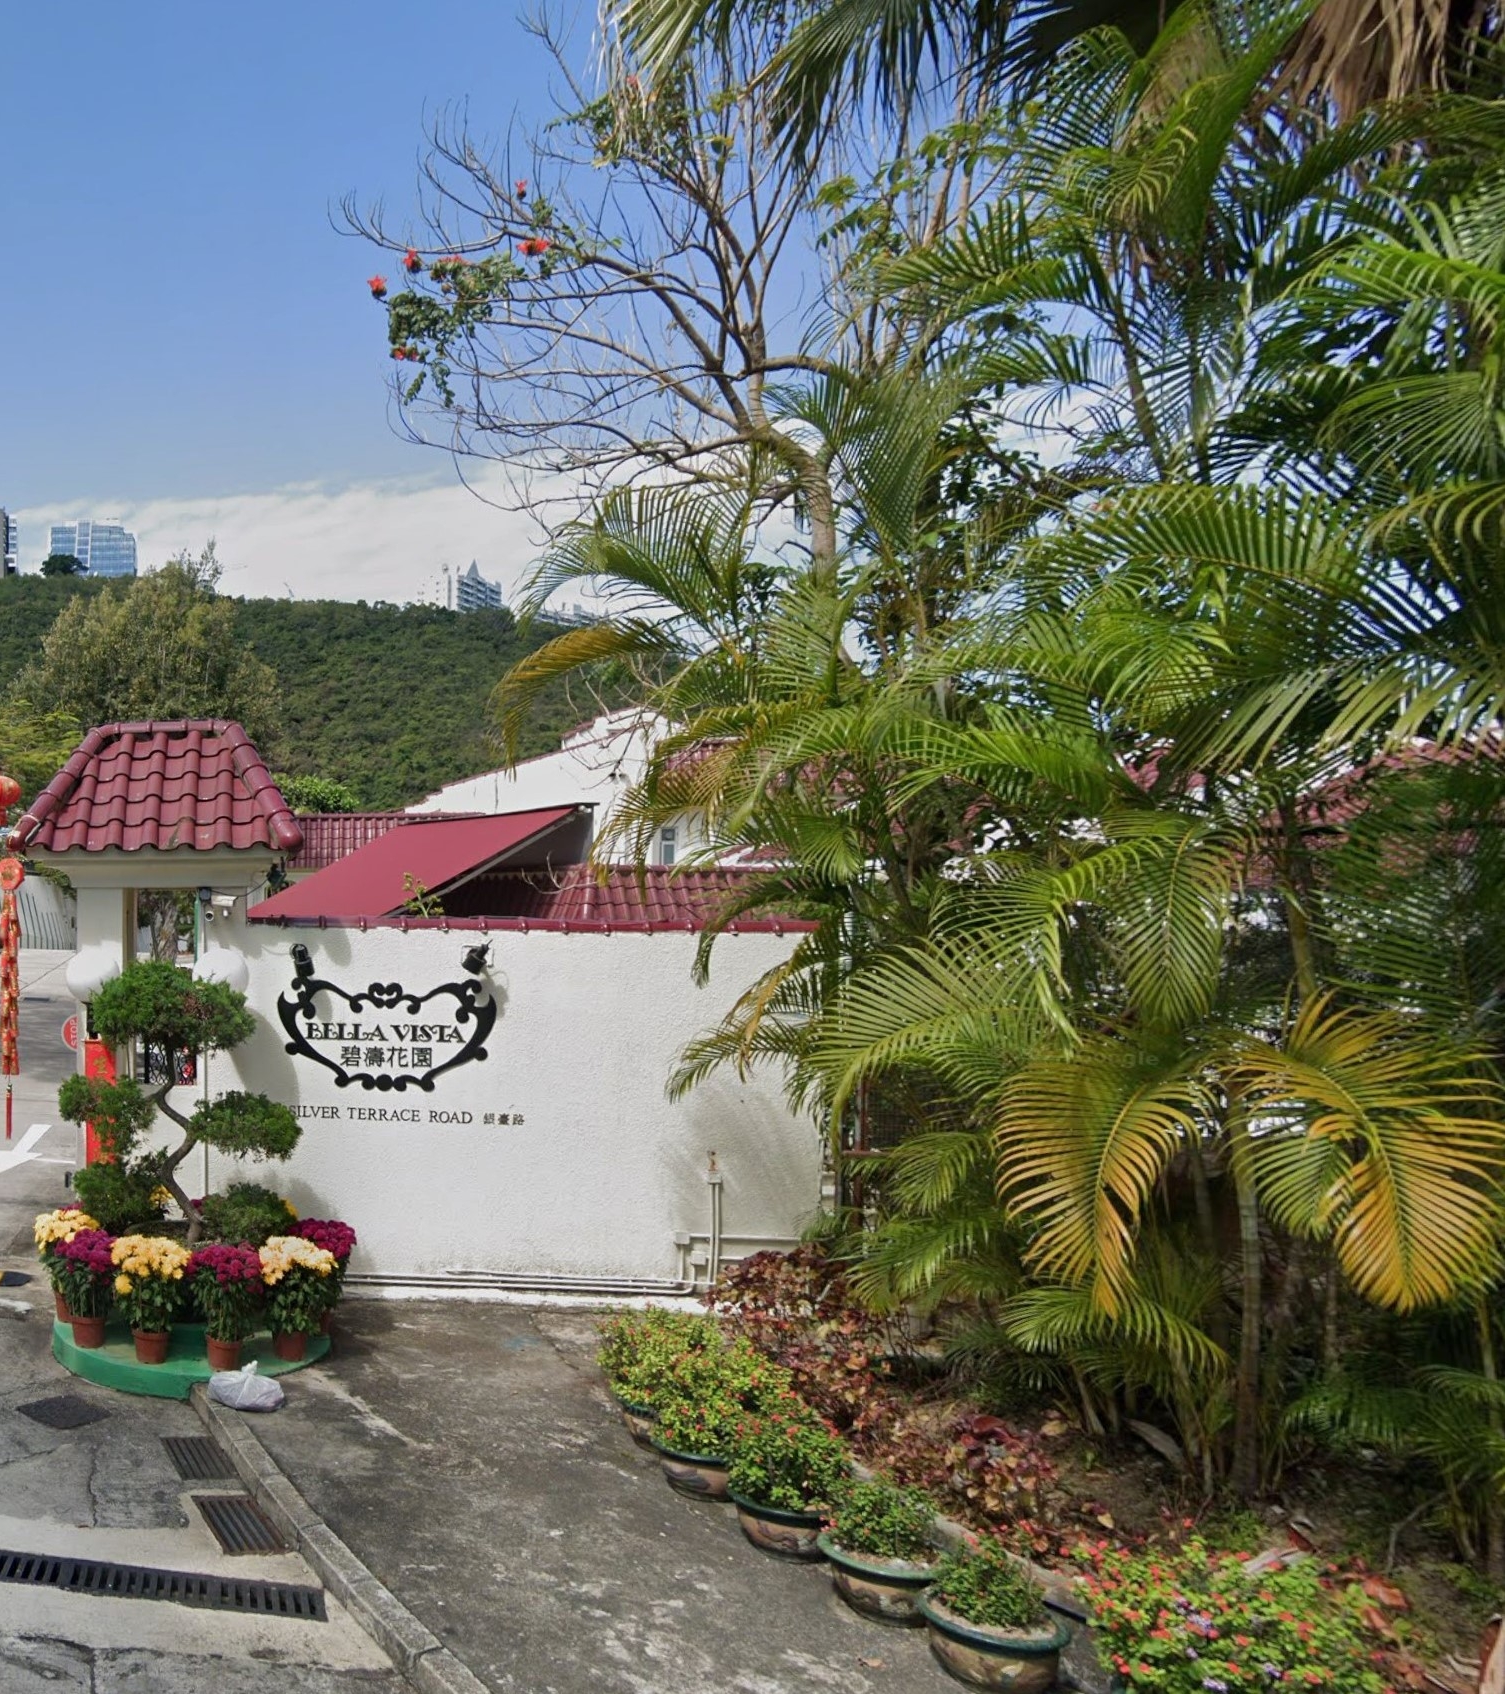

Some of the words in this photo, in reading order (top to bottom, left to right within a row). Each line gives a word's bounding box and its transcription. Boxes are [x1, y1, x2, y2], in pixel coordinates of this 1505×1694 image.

[305, 1022, 388, 1041] BELLA
[390, 1023, 467, 1043] VISTA
[340, 1045, 433, 1068] 碧濤花園
[289, 1105, 341, 1119] SILVER
[347, 1107, 421, 1122] TERRACE
[429, 1110, 473, 1124] ROAD
